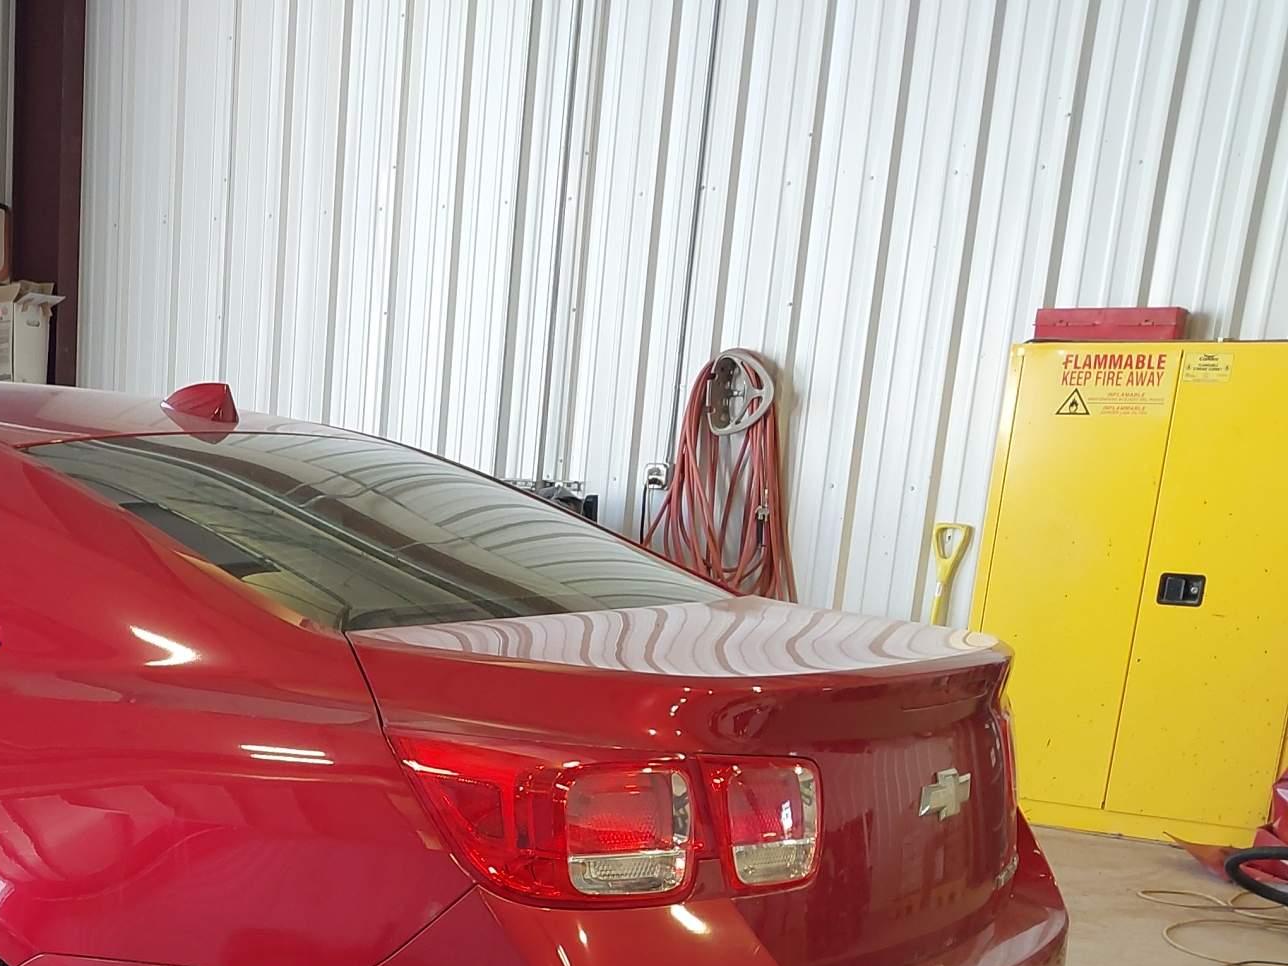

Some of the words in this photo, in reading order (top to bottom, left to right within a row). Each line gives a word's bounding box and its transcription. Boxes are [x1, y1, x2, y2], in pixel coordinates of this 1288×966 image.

[1063, 354, 1167, 370] FLAMMABLE
[1061, 371, 1092, 386] KEEP
[1094, 371, 1123, 387] FIRE
[1126, 371, 1165, 387] AWAY
